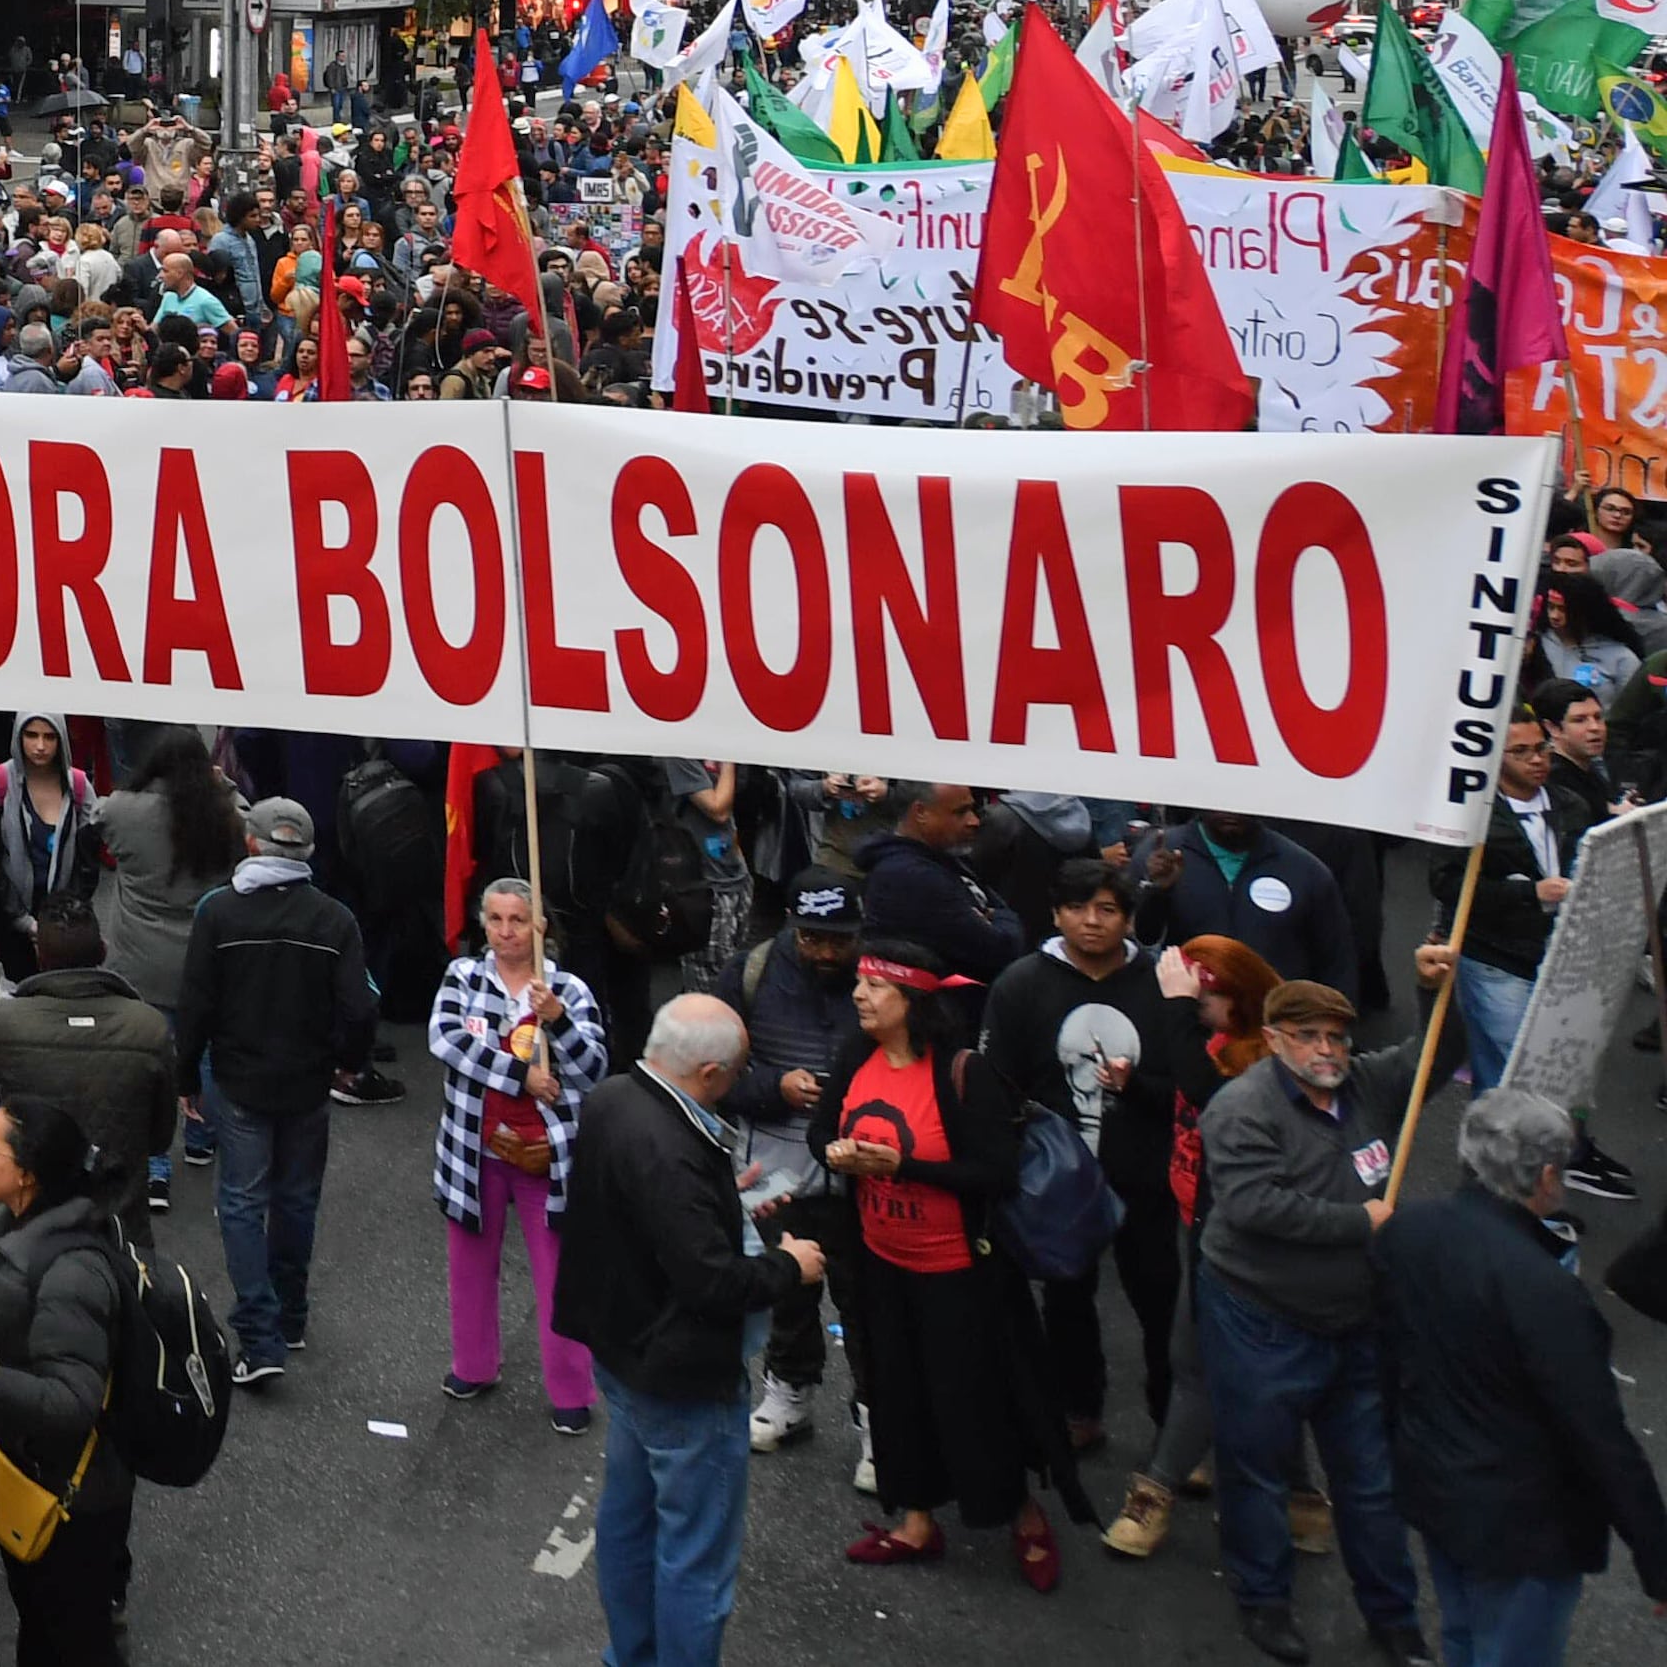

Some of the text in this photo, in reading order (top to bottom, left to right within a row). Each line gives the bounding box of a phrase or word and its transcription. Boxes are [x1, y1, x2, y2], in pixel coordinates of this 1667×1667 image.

[1447, 59, 1495, 109] Banc
[286, 443, 1389, 780] BOLSONARO
[1448, 478, 1521, 805] SINTUSP
